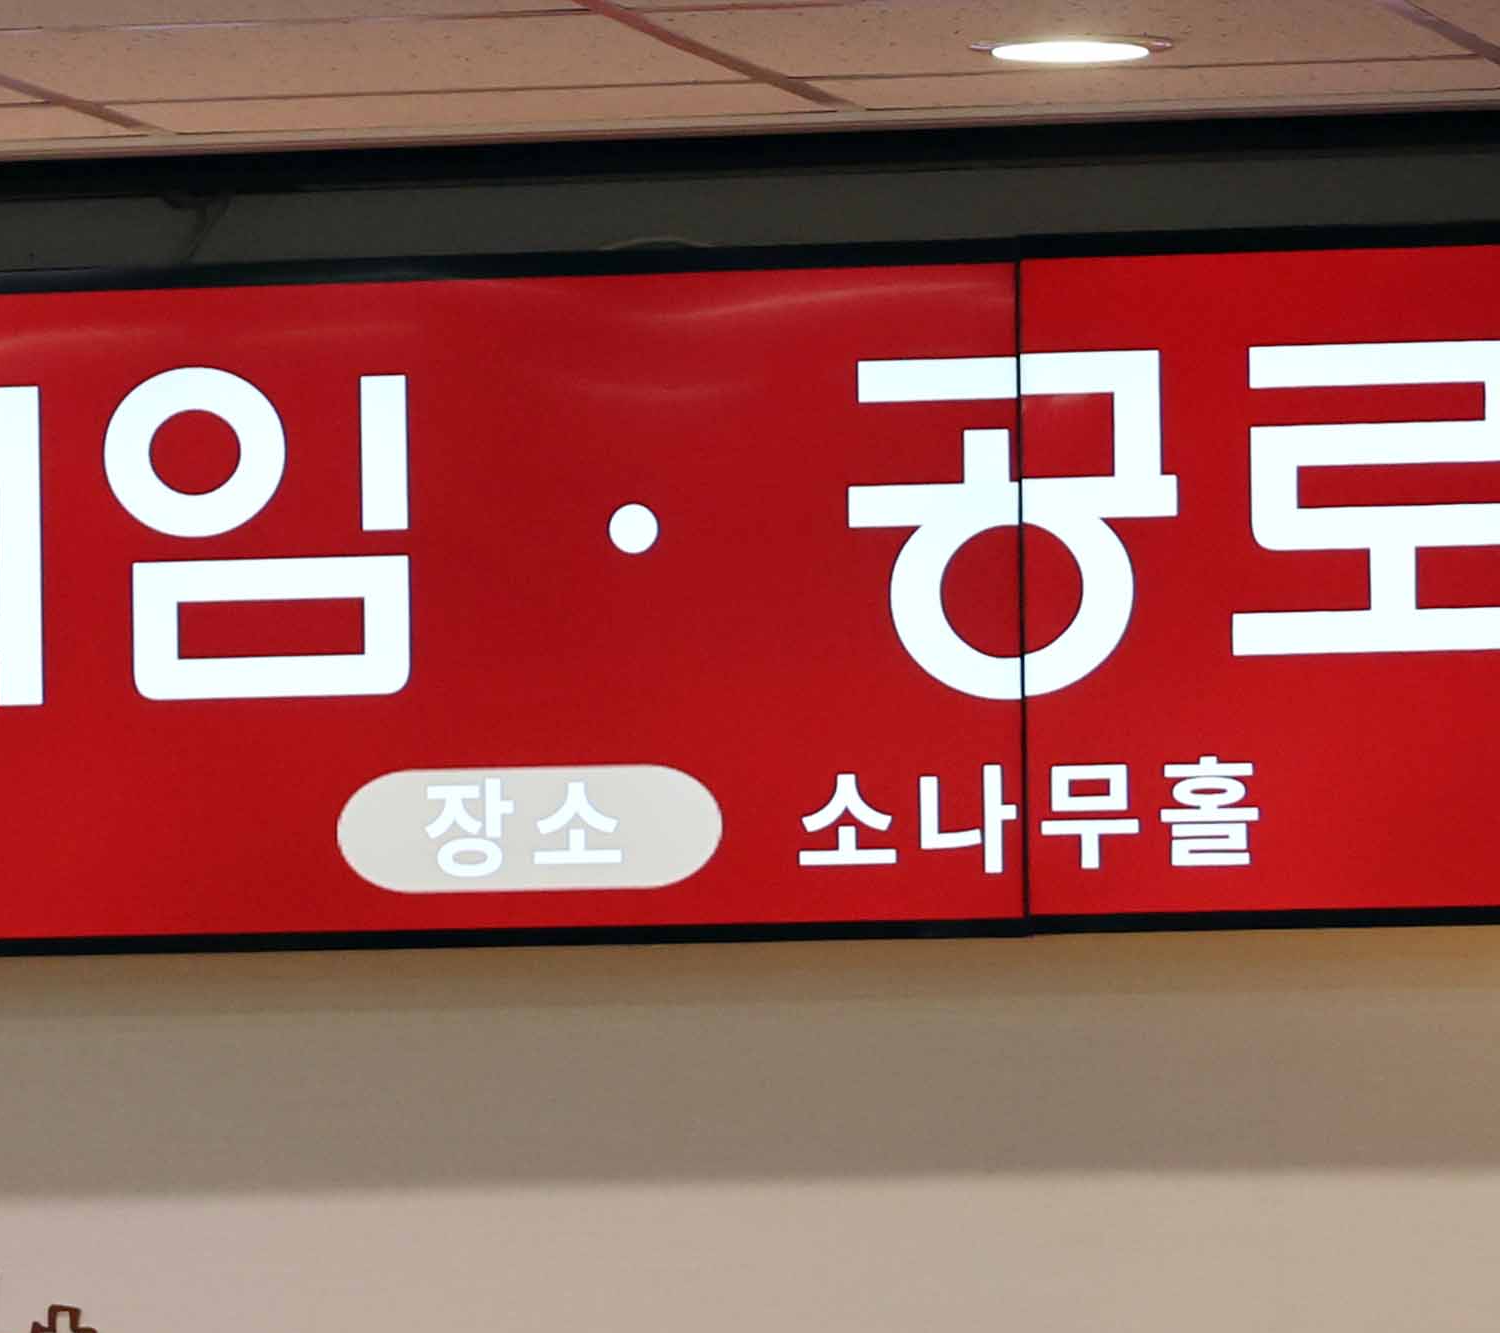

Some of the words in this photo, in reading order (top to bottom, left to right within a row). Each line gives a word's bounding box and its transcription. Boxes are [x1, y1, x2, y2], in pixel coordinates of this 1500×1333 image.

[847, 340, 1500, 701] 공로
[424, 777, 623, 878] 장소
[798, 754, 1260, 875] 소나무홀
